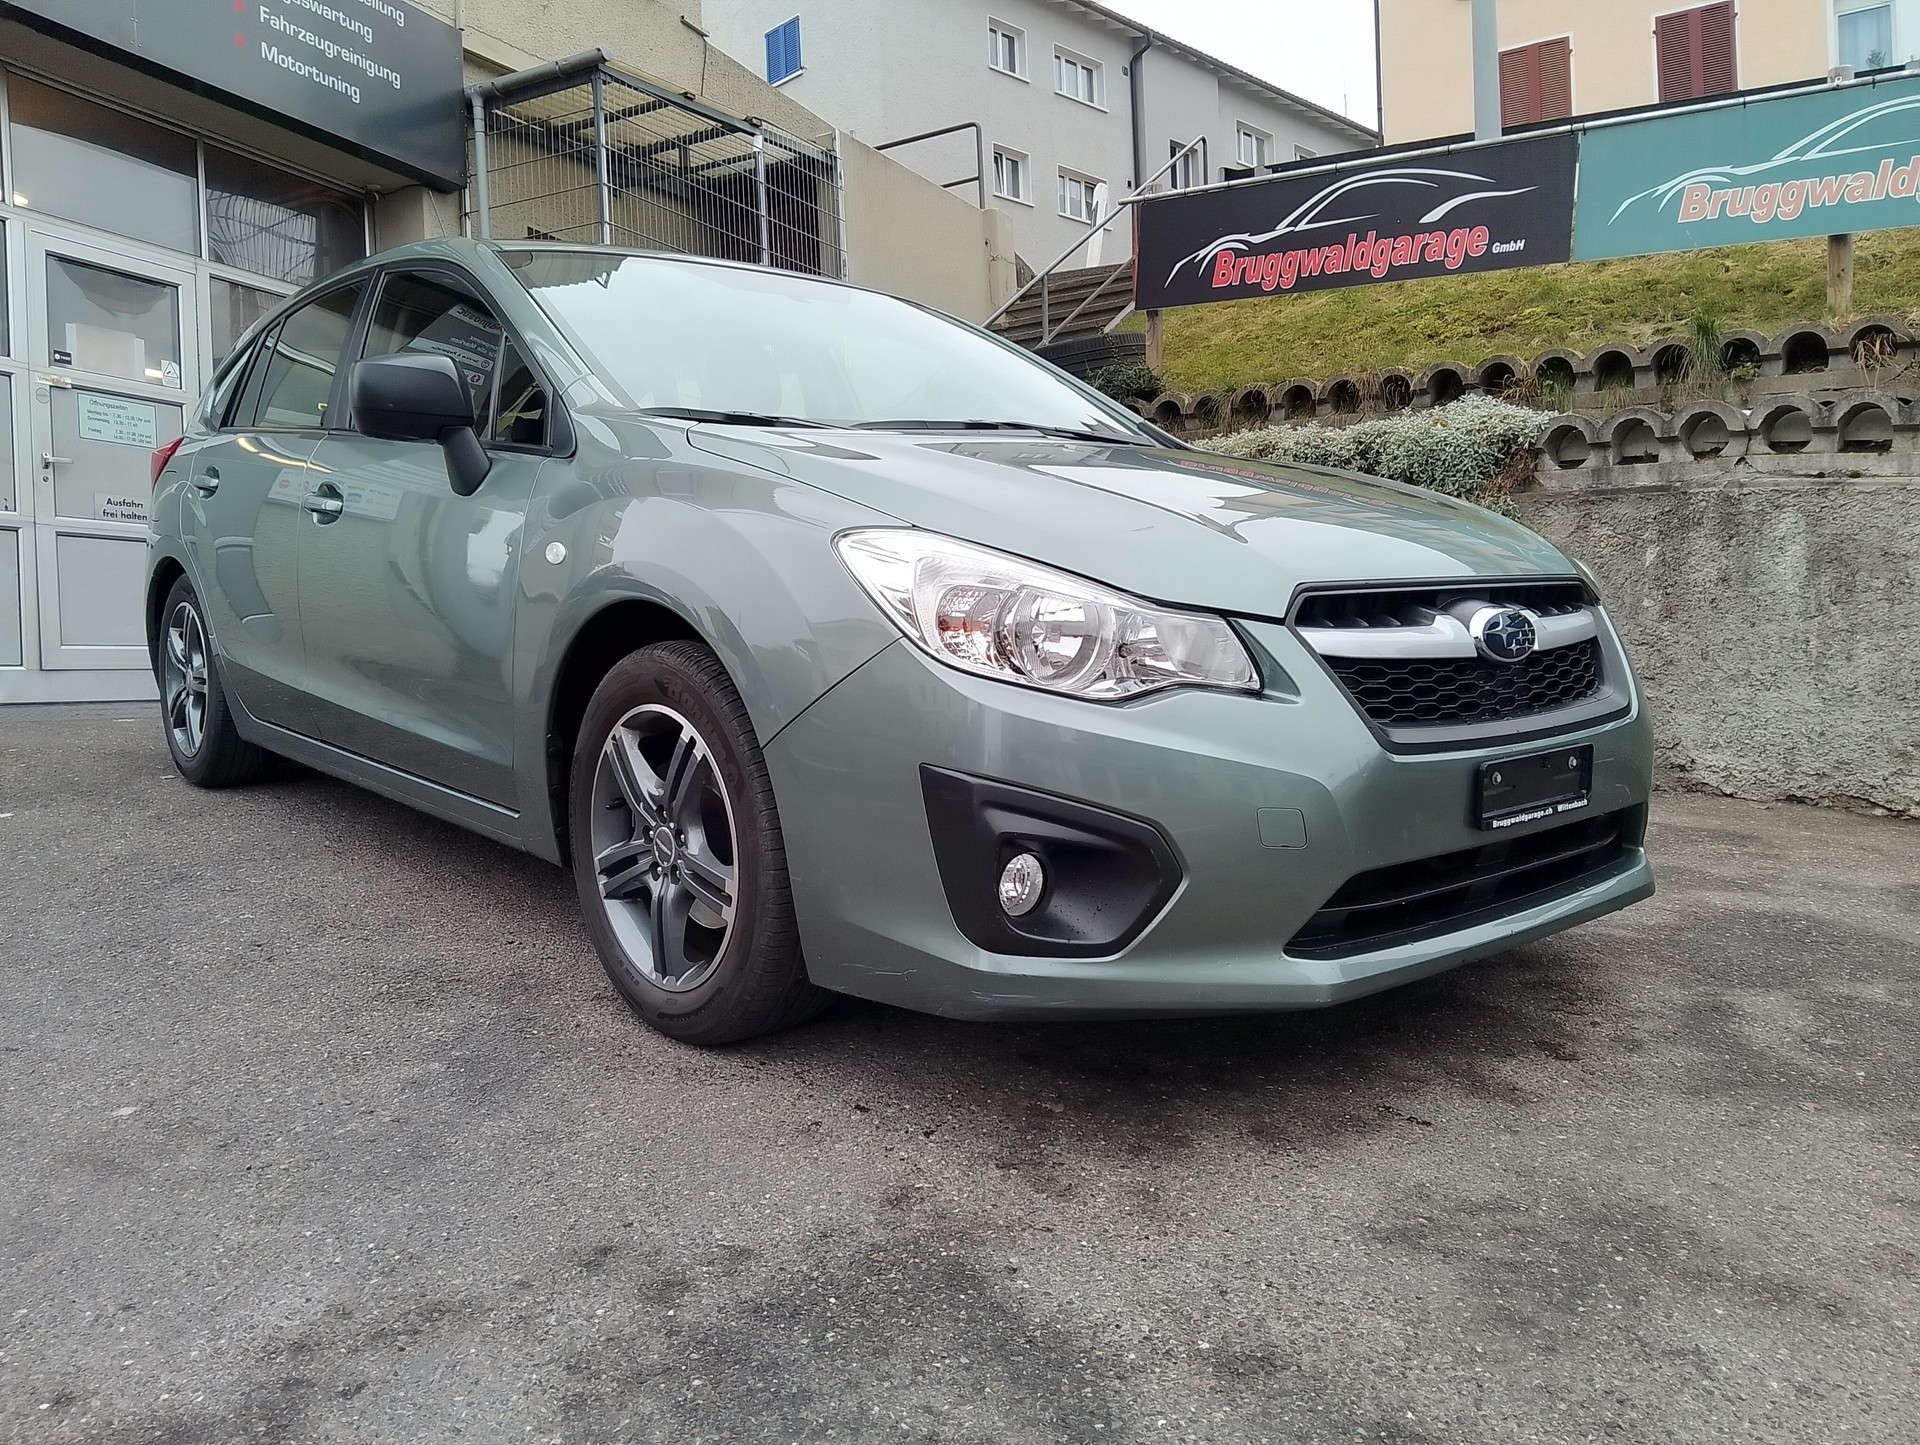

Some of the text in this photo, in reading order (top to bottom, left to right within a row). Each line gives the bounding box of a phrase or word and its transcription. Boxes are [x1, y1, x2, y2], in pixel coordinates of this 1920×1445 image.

[259, 4, 401, 90] Fahrzeugreinigung
[260, 41, 361, 104] Motortuning
[1677, 155, 1920, 223] Bruggwald
[1211, 224, 1526, 292] Bruggwaldgarage GmbH
[102, 508, 148, 522] frei halten
[1492, 798, 1588, 829] Bruggwaldgarage.ch Wittenbach
